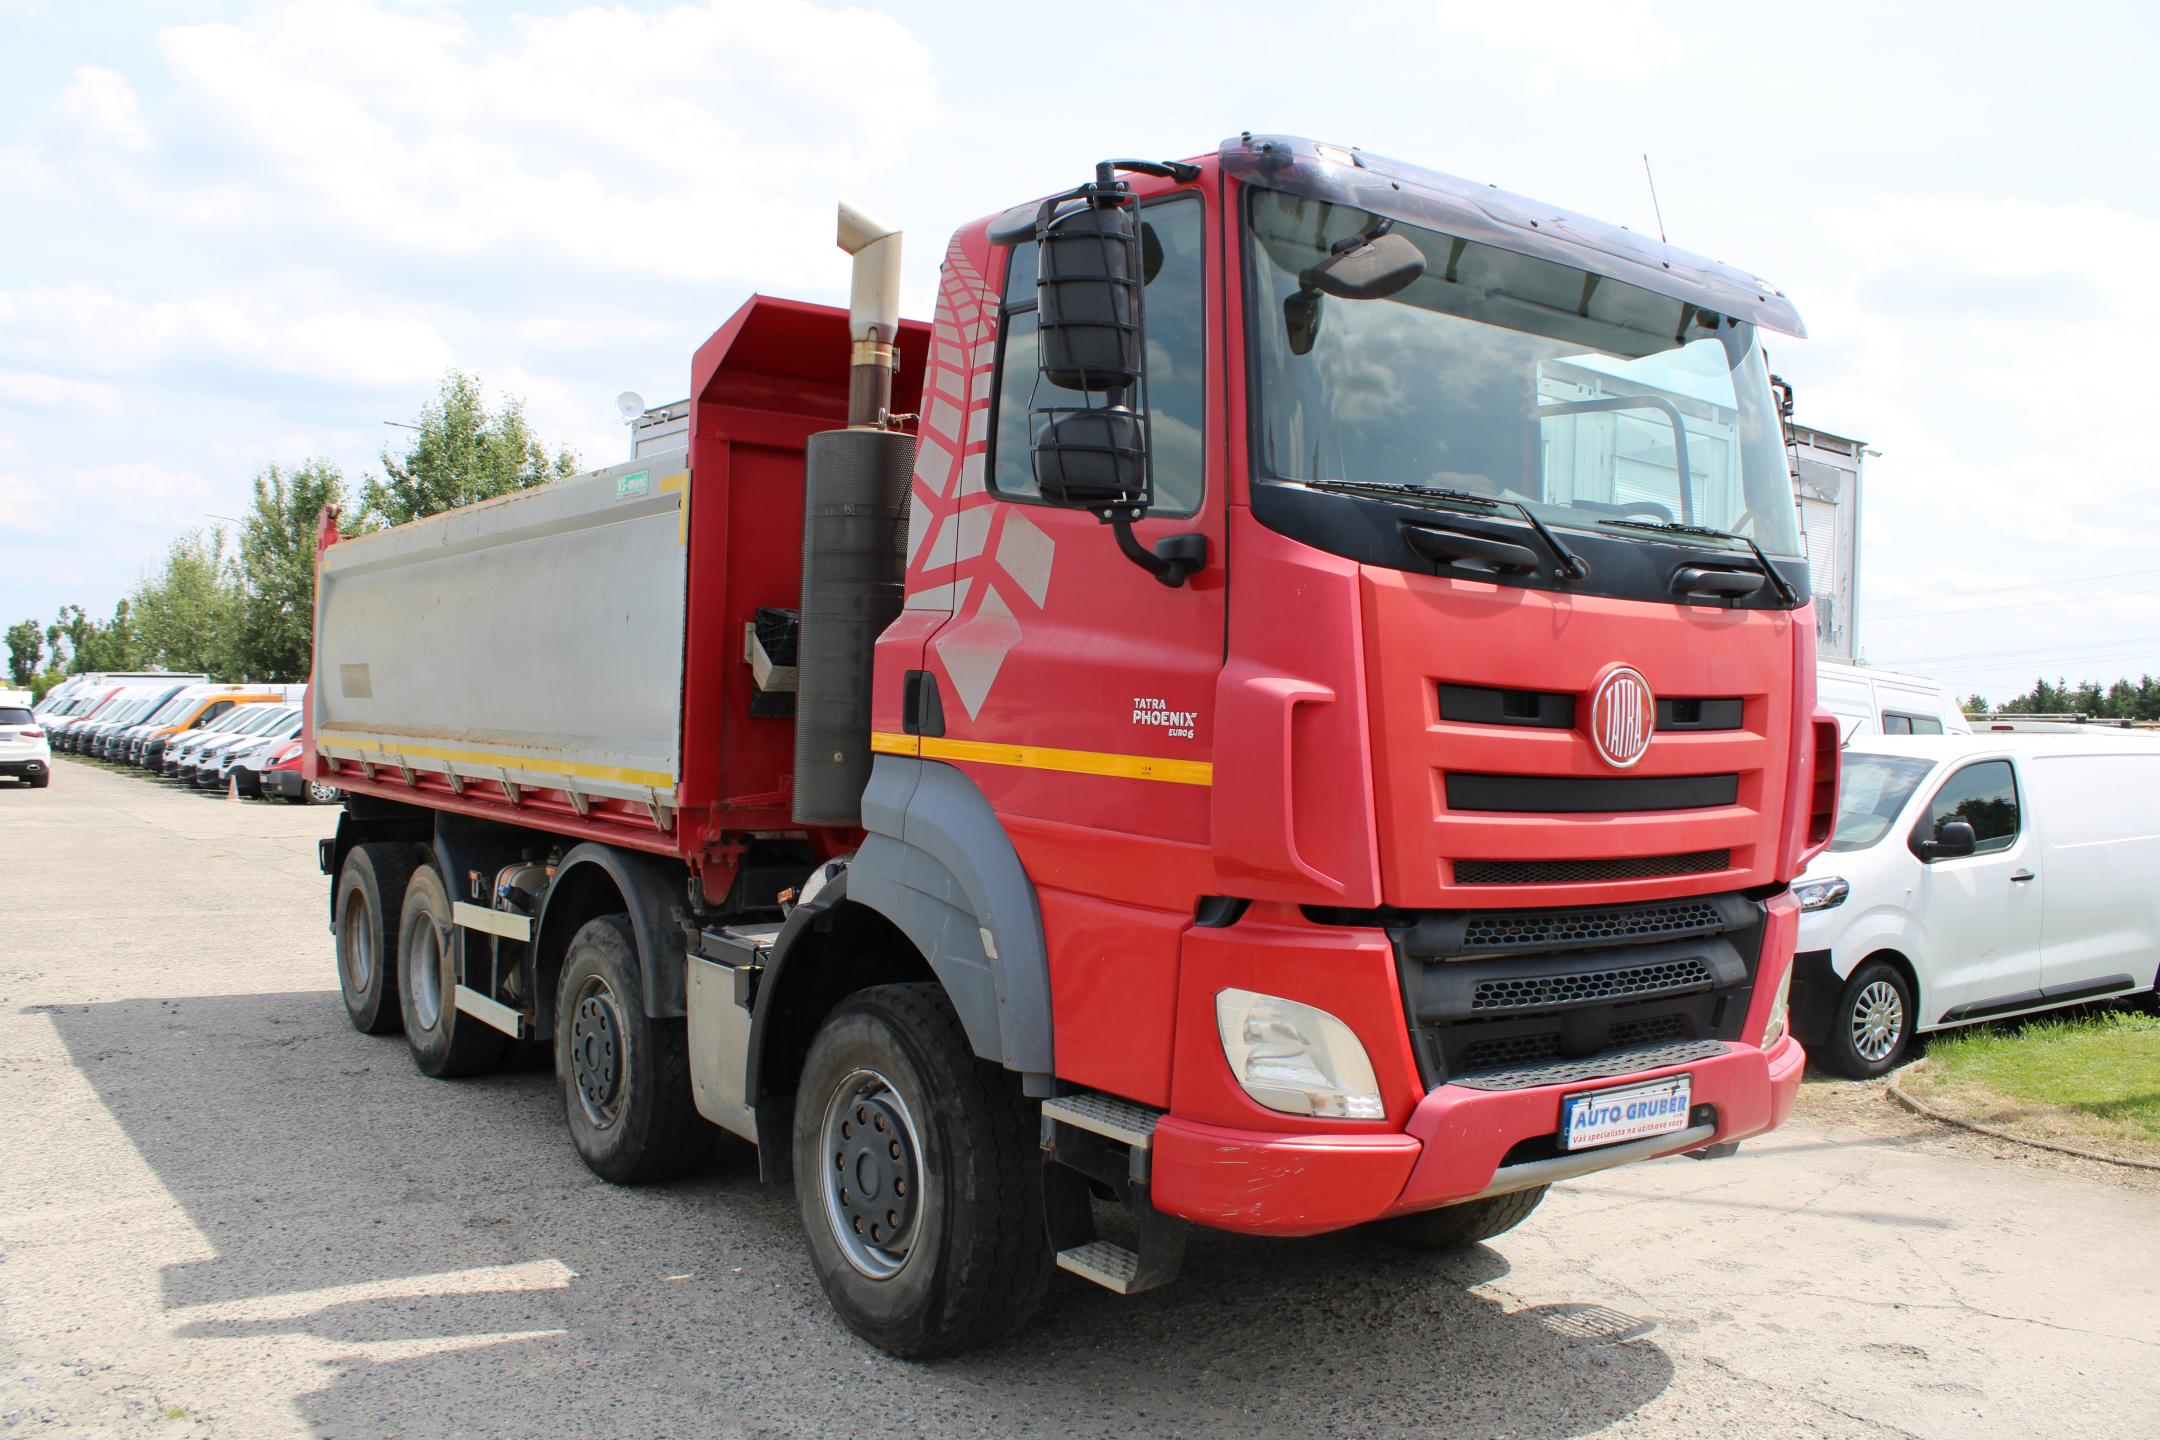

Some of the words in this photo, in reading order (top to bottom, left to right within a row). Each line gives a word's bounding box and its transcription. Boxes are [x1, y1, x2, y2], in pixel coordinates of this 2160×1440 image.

[1133, 698, 1166, 709] TATRA
[1132, 710, 1198, 727] PHOENIX
[1605, 679, 1642, 757] TATRA
[1574, 1106, 1622, 1129] AUTO
[1626, 1095, 1687, 1120] GRUBER
[1588, 1129, 1625, 1142] specialista
[1627, 1127, 1636, 1136] na
[1669, 1120, 1683, 1128] vozy
